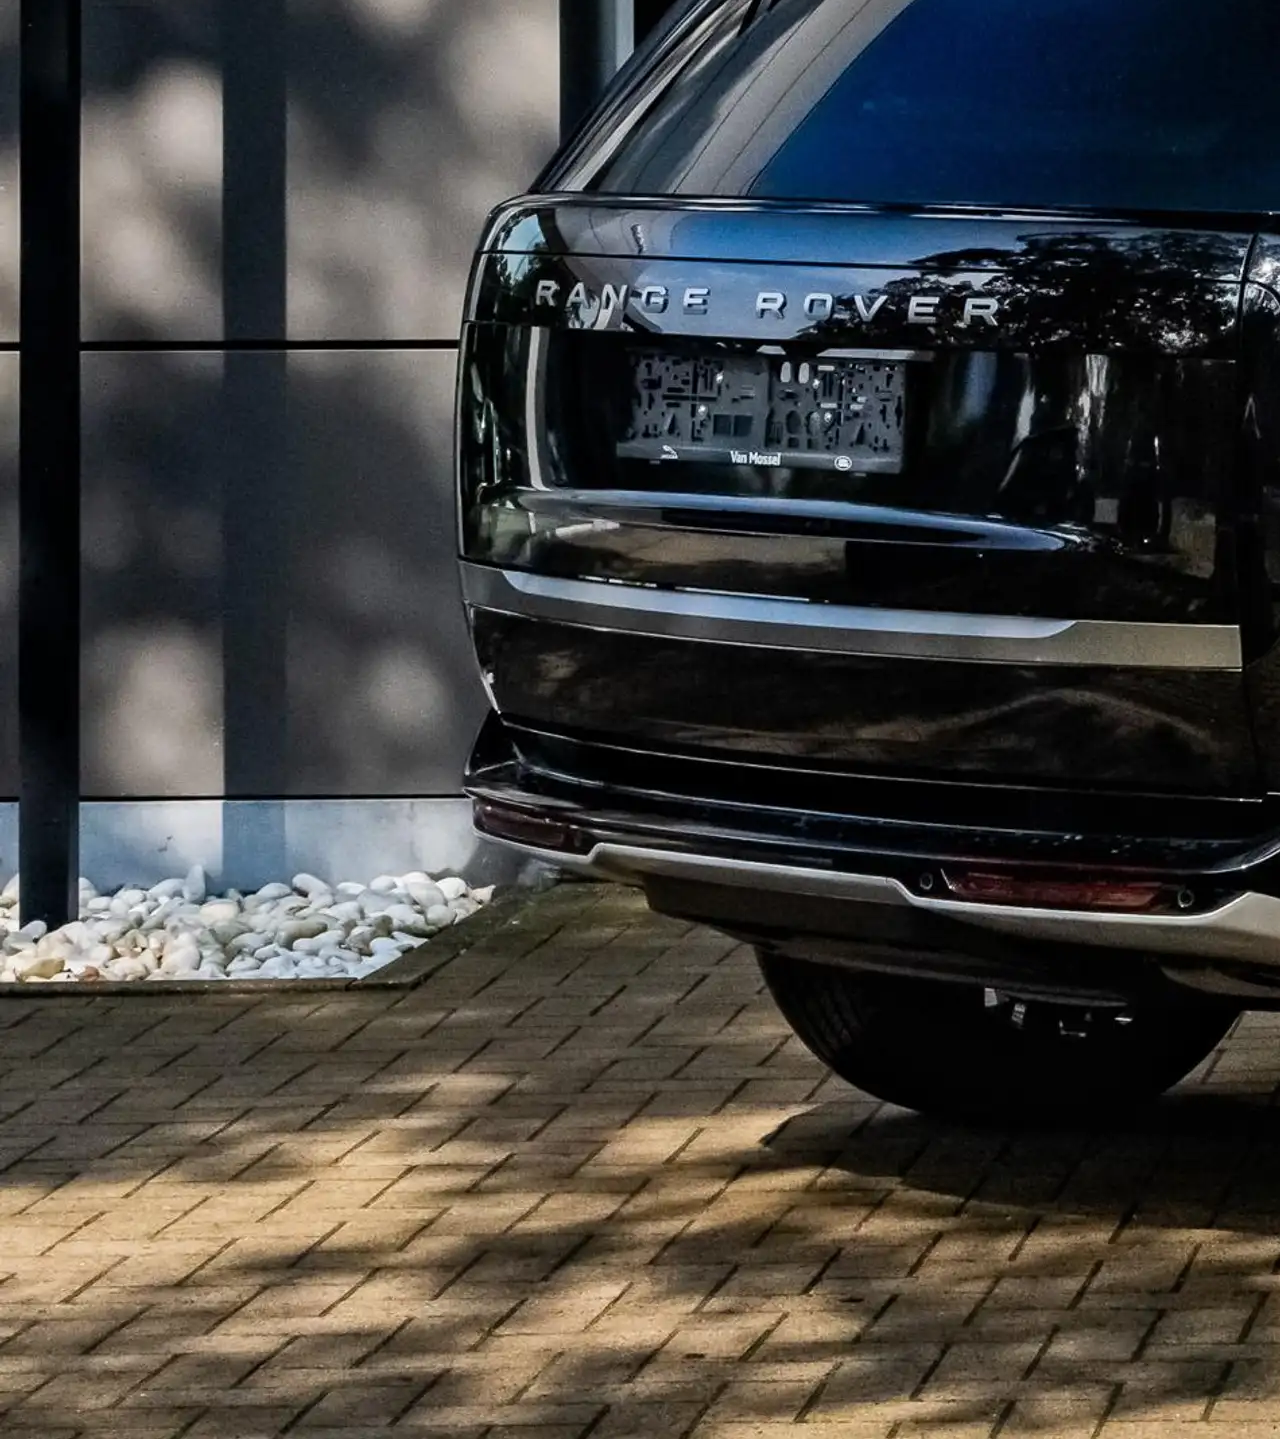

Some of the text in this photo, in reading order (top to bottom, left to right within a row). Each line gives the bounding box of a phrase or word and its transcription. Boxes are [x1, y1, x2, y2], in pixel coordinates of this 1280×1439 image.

[534, 279, 999, 326] RANGE ROVER
[730, 450, 781, 467] Van Mossel
